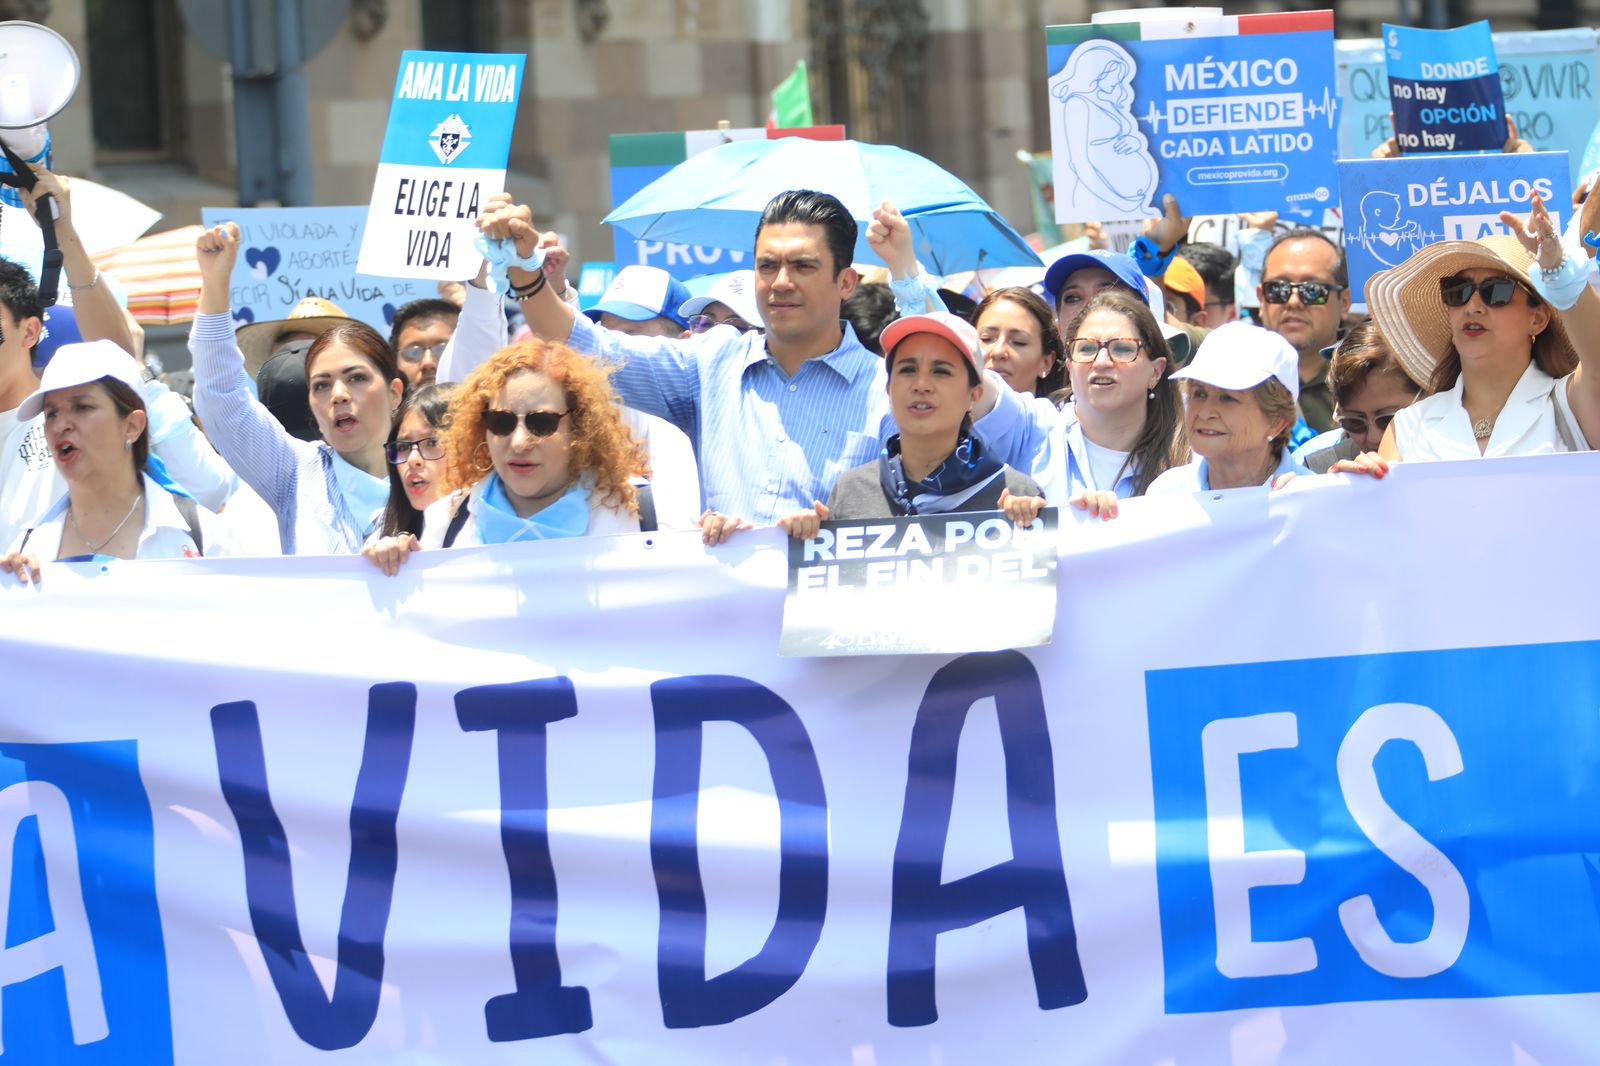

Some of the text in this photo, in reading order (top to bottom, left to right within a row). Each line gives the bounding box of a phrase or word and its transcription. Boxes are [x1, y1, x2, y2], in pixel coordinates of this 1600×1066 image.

[1165, 56, 1298, 91] MÉXICO
[1420, 57, 1489, 79] DONDE
[1523, 60, 1592, 100] VIVIR
[398, 62, 516, 103] AMA LA VIDA
[1393, 83, 1447, 104] no hay
[1173, 100, 1297, 126] DEFIENDE
[1420, 103, 1496, 125] OPCIÓN
[1160, 132, 1313, 159] CADA LATIDO
[1398, 130, 1456, 150] no hay
[1198, 167, 1278, 180] mexicoprovida.org
[394, 178, 480, 219] ELIGE LA
[1407, 177, 1553, 207] DÉJALOS
[259, 223, 338, 242] VIOLADA
[350, 224, 359, 242] Y
[406, 230, 452, 268] VIDA
[231, 283, 272, 310] ECIR
[392, 283, 416, 296] DE
[804, 522, 933, 561] REZA
[798, 551, 1049, 596] EL FIN DEL
[210, 652, 1088, 1051] VIDA
[1202, 702, 1470, 980] ES
